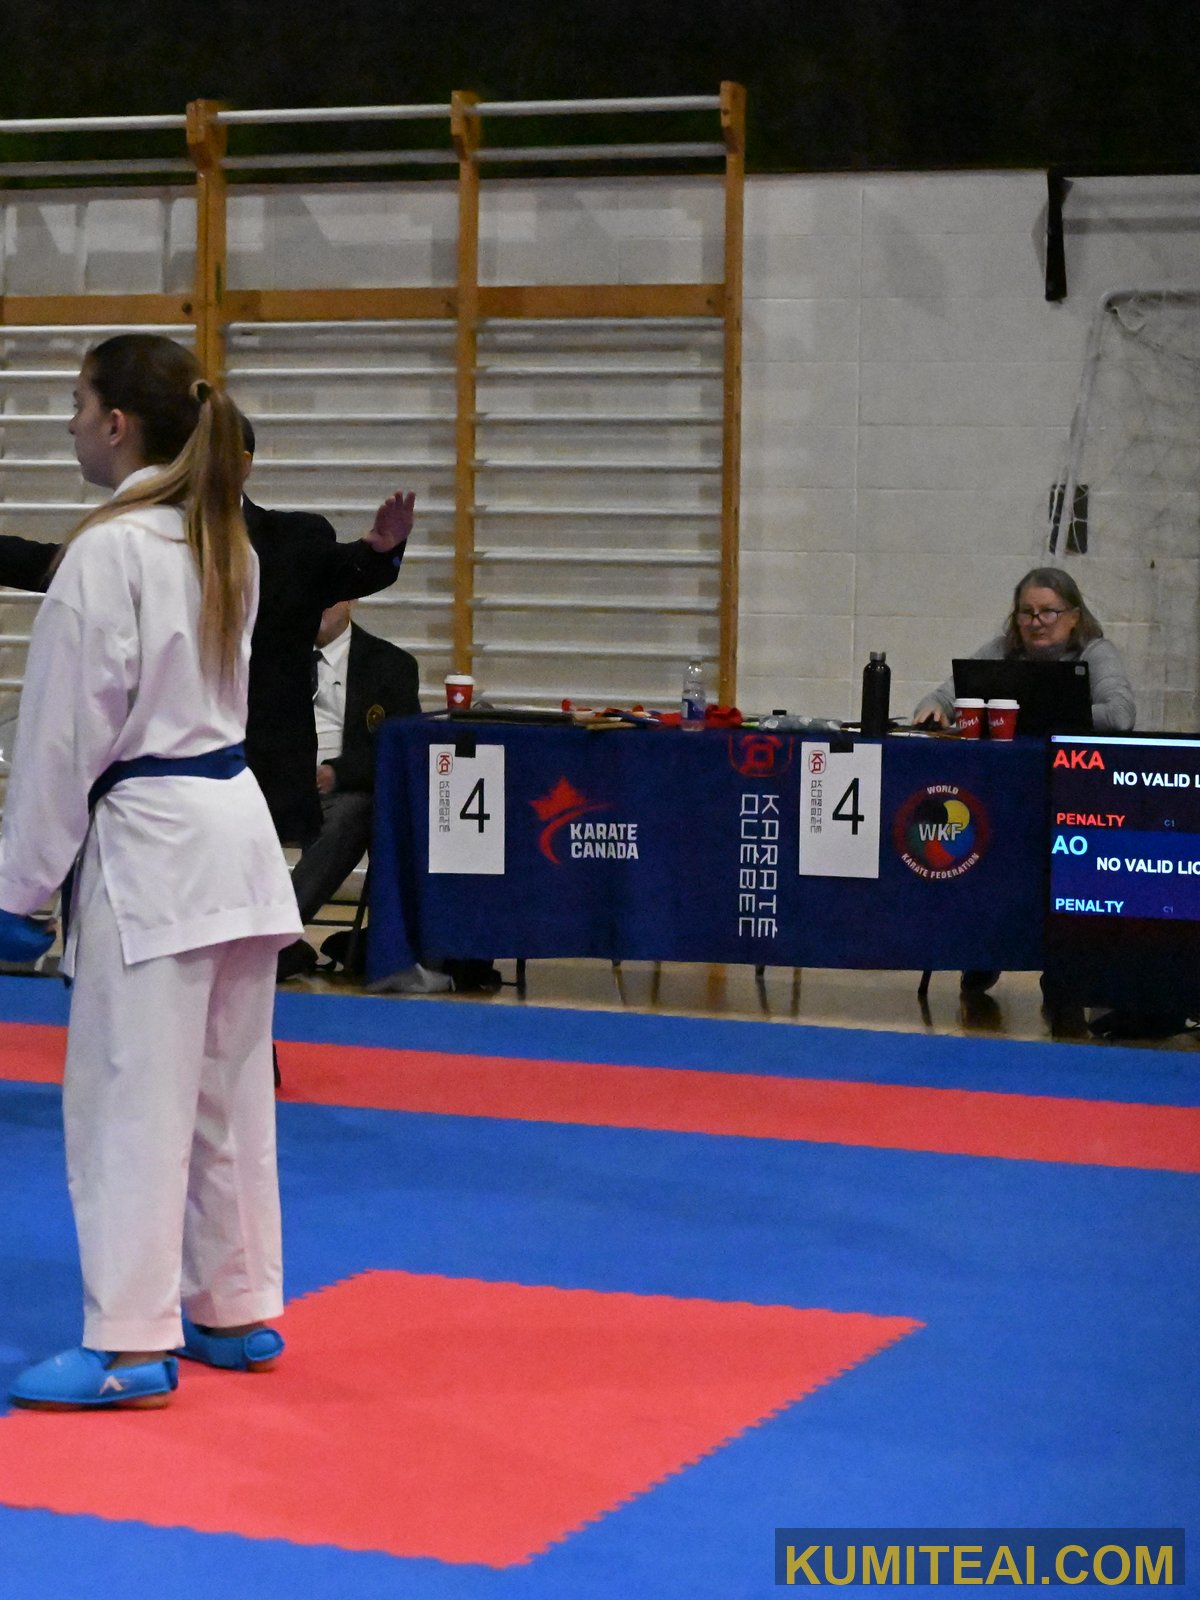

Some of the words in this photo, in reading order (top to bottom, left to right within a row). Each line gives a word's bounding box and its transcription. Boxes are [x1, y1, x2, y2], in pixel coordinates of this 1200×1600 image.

[1053, 749, 1105, 770] AKA
[1113, 771, 1138, 786] NO
[1141, 772, 1191, 788] VALID
[927, 785, 959, 795] WORLD
[459, 777, 491, 833] 4
[832, 777, 865, 835] 4
[1056, 812, 1126, 828] PENALTY
[570, 823, 638, 841] KARATE
[918, 823, 963, 841] WKF
[571, 842, 639, 859] CANADA
[1051, 834, 1088, 855] AO
[738, 793, 759, 938] QUÉBEC
[758, 794, 780, 939] KARATÉ
[901, 853, 929, 878] KARATE
[930, 852, 980, 879] FEDERATION
[1096, 857, 1121, 871] NO
[1124, 858, 1174, 874] VALID
[1055, 898, 1125, 914] PENALTY
